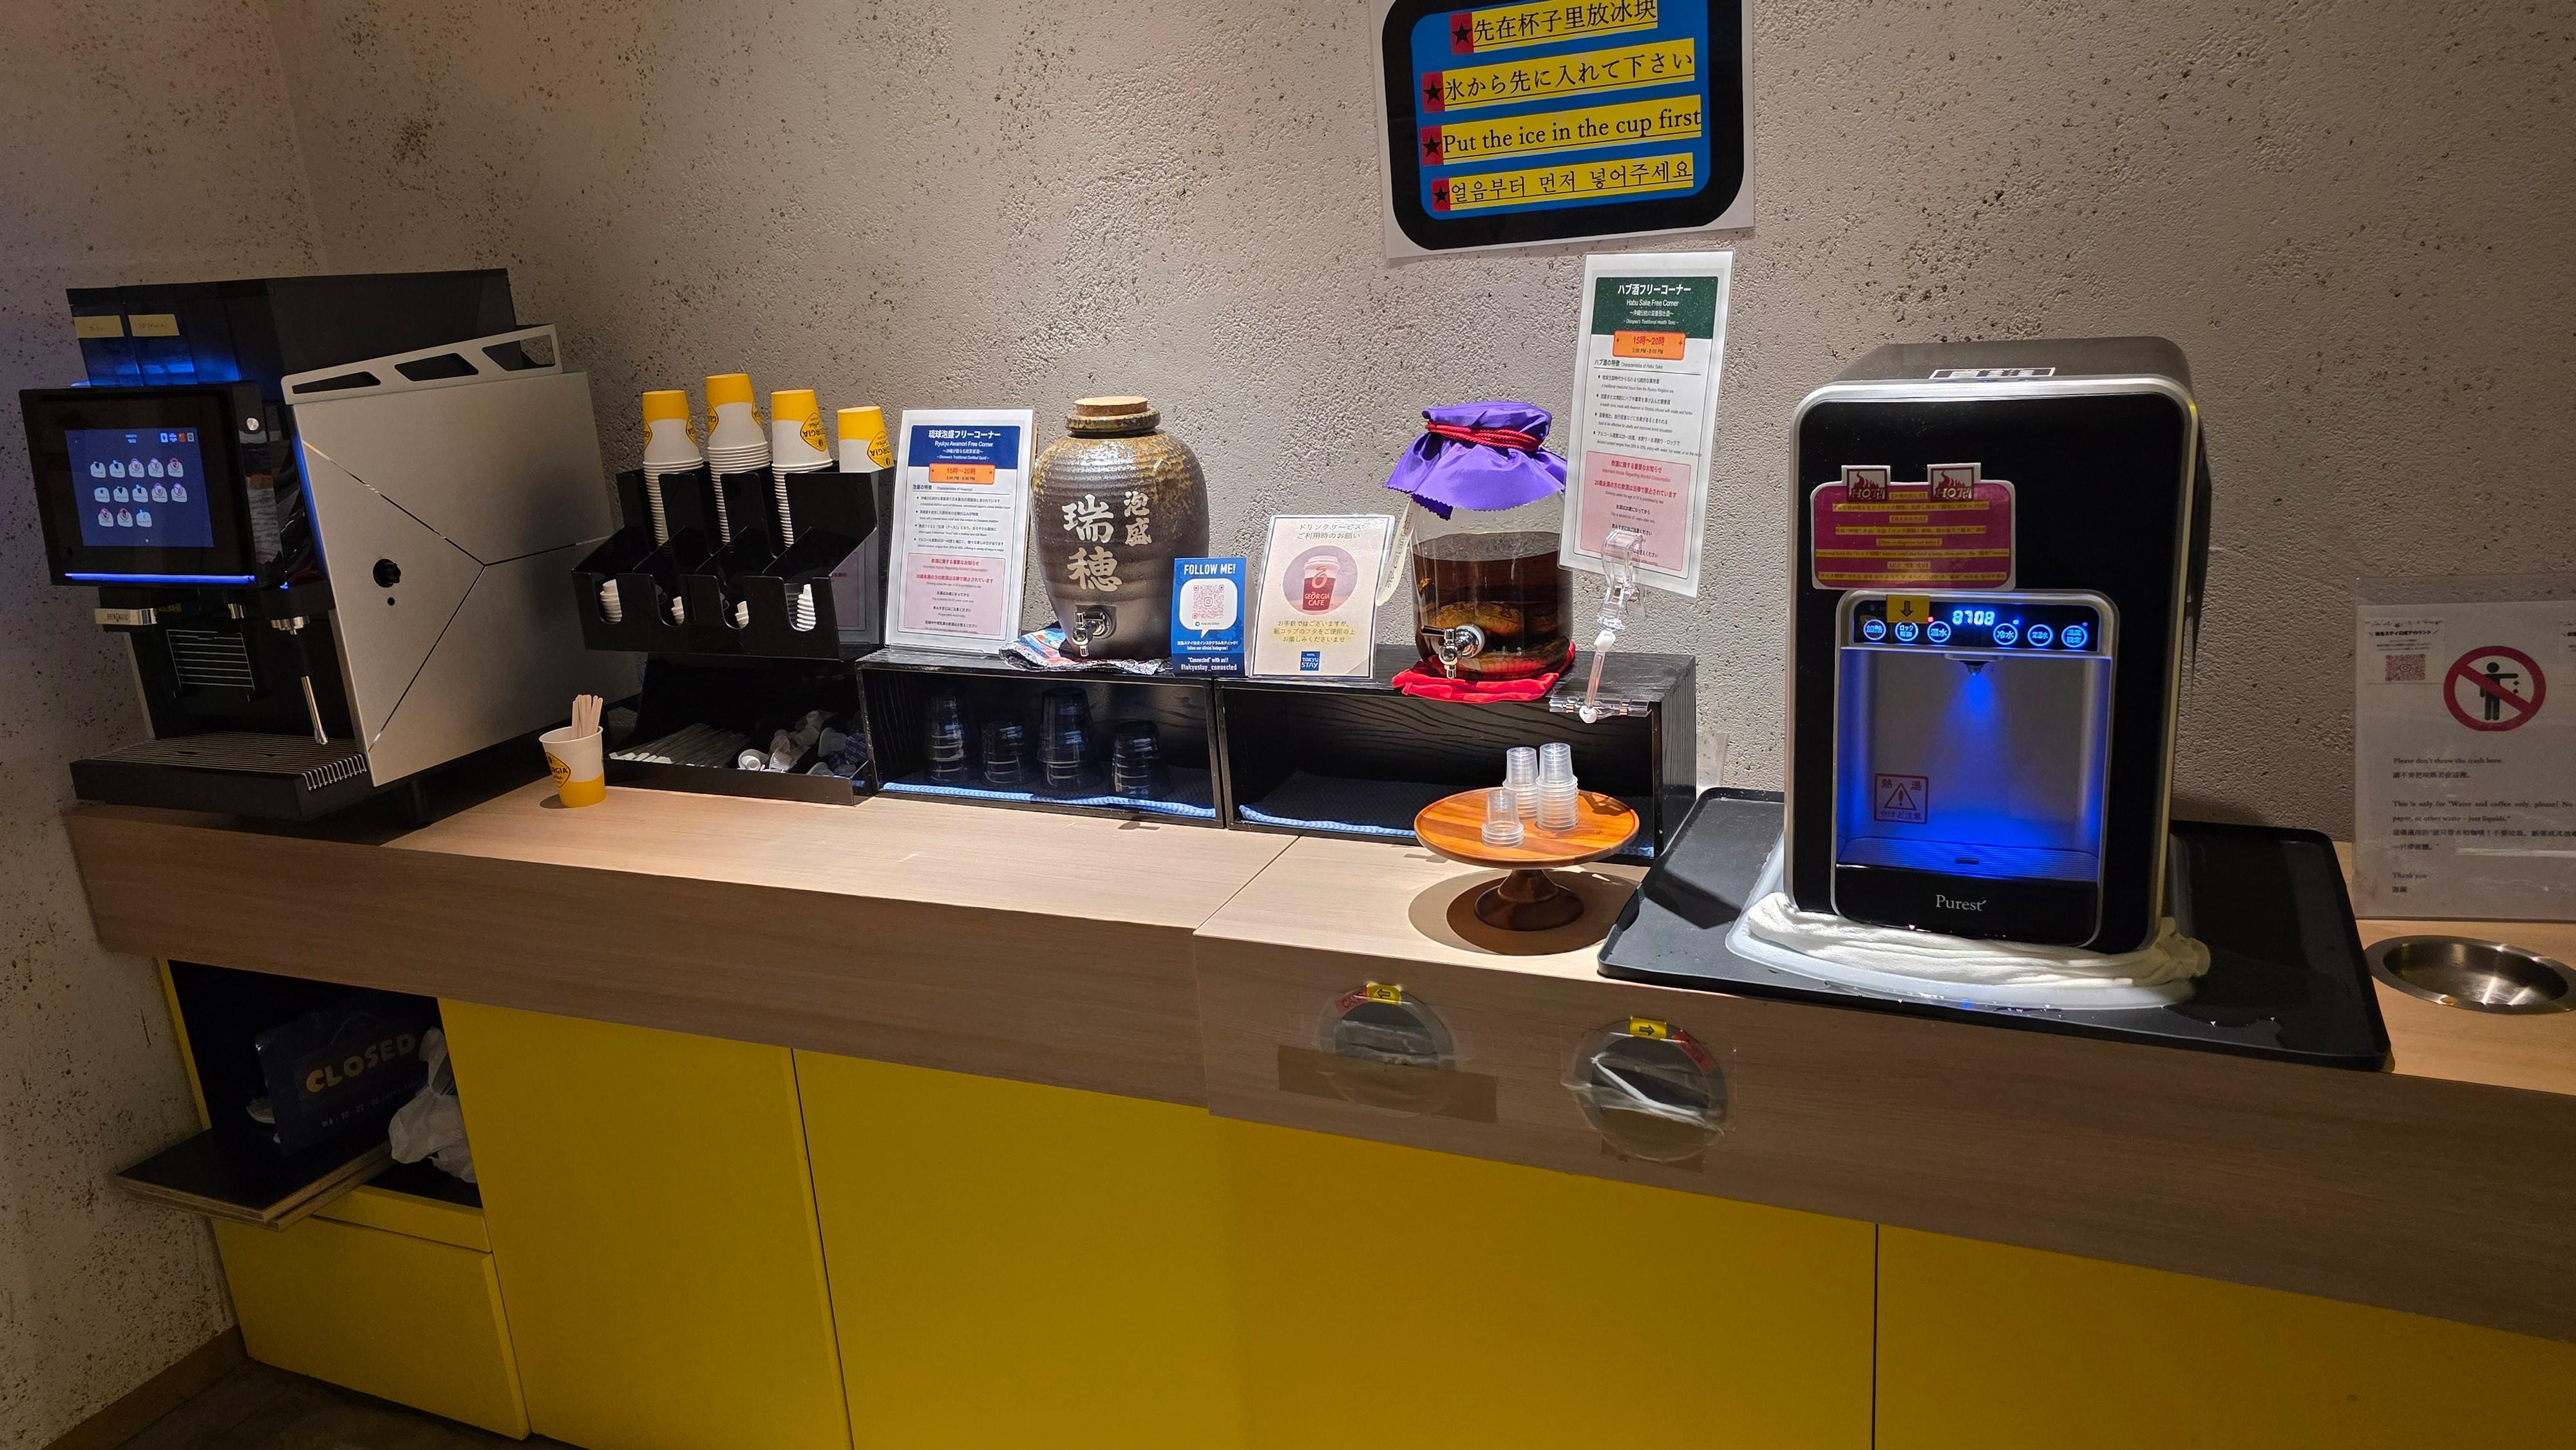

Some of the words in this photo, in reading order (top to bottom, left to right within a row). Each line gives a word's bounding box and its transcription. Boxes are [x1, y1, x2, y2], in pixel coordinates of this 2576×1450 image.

[1473, 0, 1657, 43] 先在杯子里放冰块
[1444, 52, 1693, 101] 氷から先に入れて下さい
[1443, 134, 1477, 153] Put
[1483, 129, 1512, 148] the
[1519, 126, 1546, 145] ice
[1552, 122, 1571, 141] in
[1578, 119, 1609, 138] the
[1616, 118, 1651, 137] cup
[1659, 109, 1701, 128] first
[1451, 176, 1525, 203] 얼음부터
[1539, 171, 1576, 192] 먼저
[1591, 160, 1693, 189] 넣어주세요
[1618, 283, 1691, 296] ハブ酒フリーコーナー
[1633, 336, 1665, 346] 15時～20時
[928, 429, 1001, 439] 琉球泡盛フリーコーナー
[1852, 487, 1886, 499] HOT!
[1936, 487, 1971, 499] HOT!
[1124, 491, 1152, 547] 泡盛
[1297, 532, 1361, 540] ご利用時のお願い
[1061, 494, 1122, 592] 瑞穂
[1184, 564, 1218, 576] FOLLOW
[1220, 563, 1236, 574] ME!
[1931, 628, 1947, 637] 温水
[1996, 630, 2014, 639] 冷水
[1879, 810, 1922, 820] やけど注意
[1936, 894, 1987, 912] Purest
[305, 1033, 416, 1093] CLOSED
